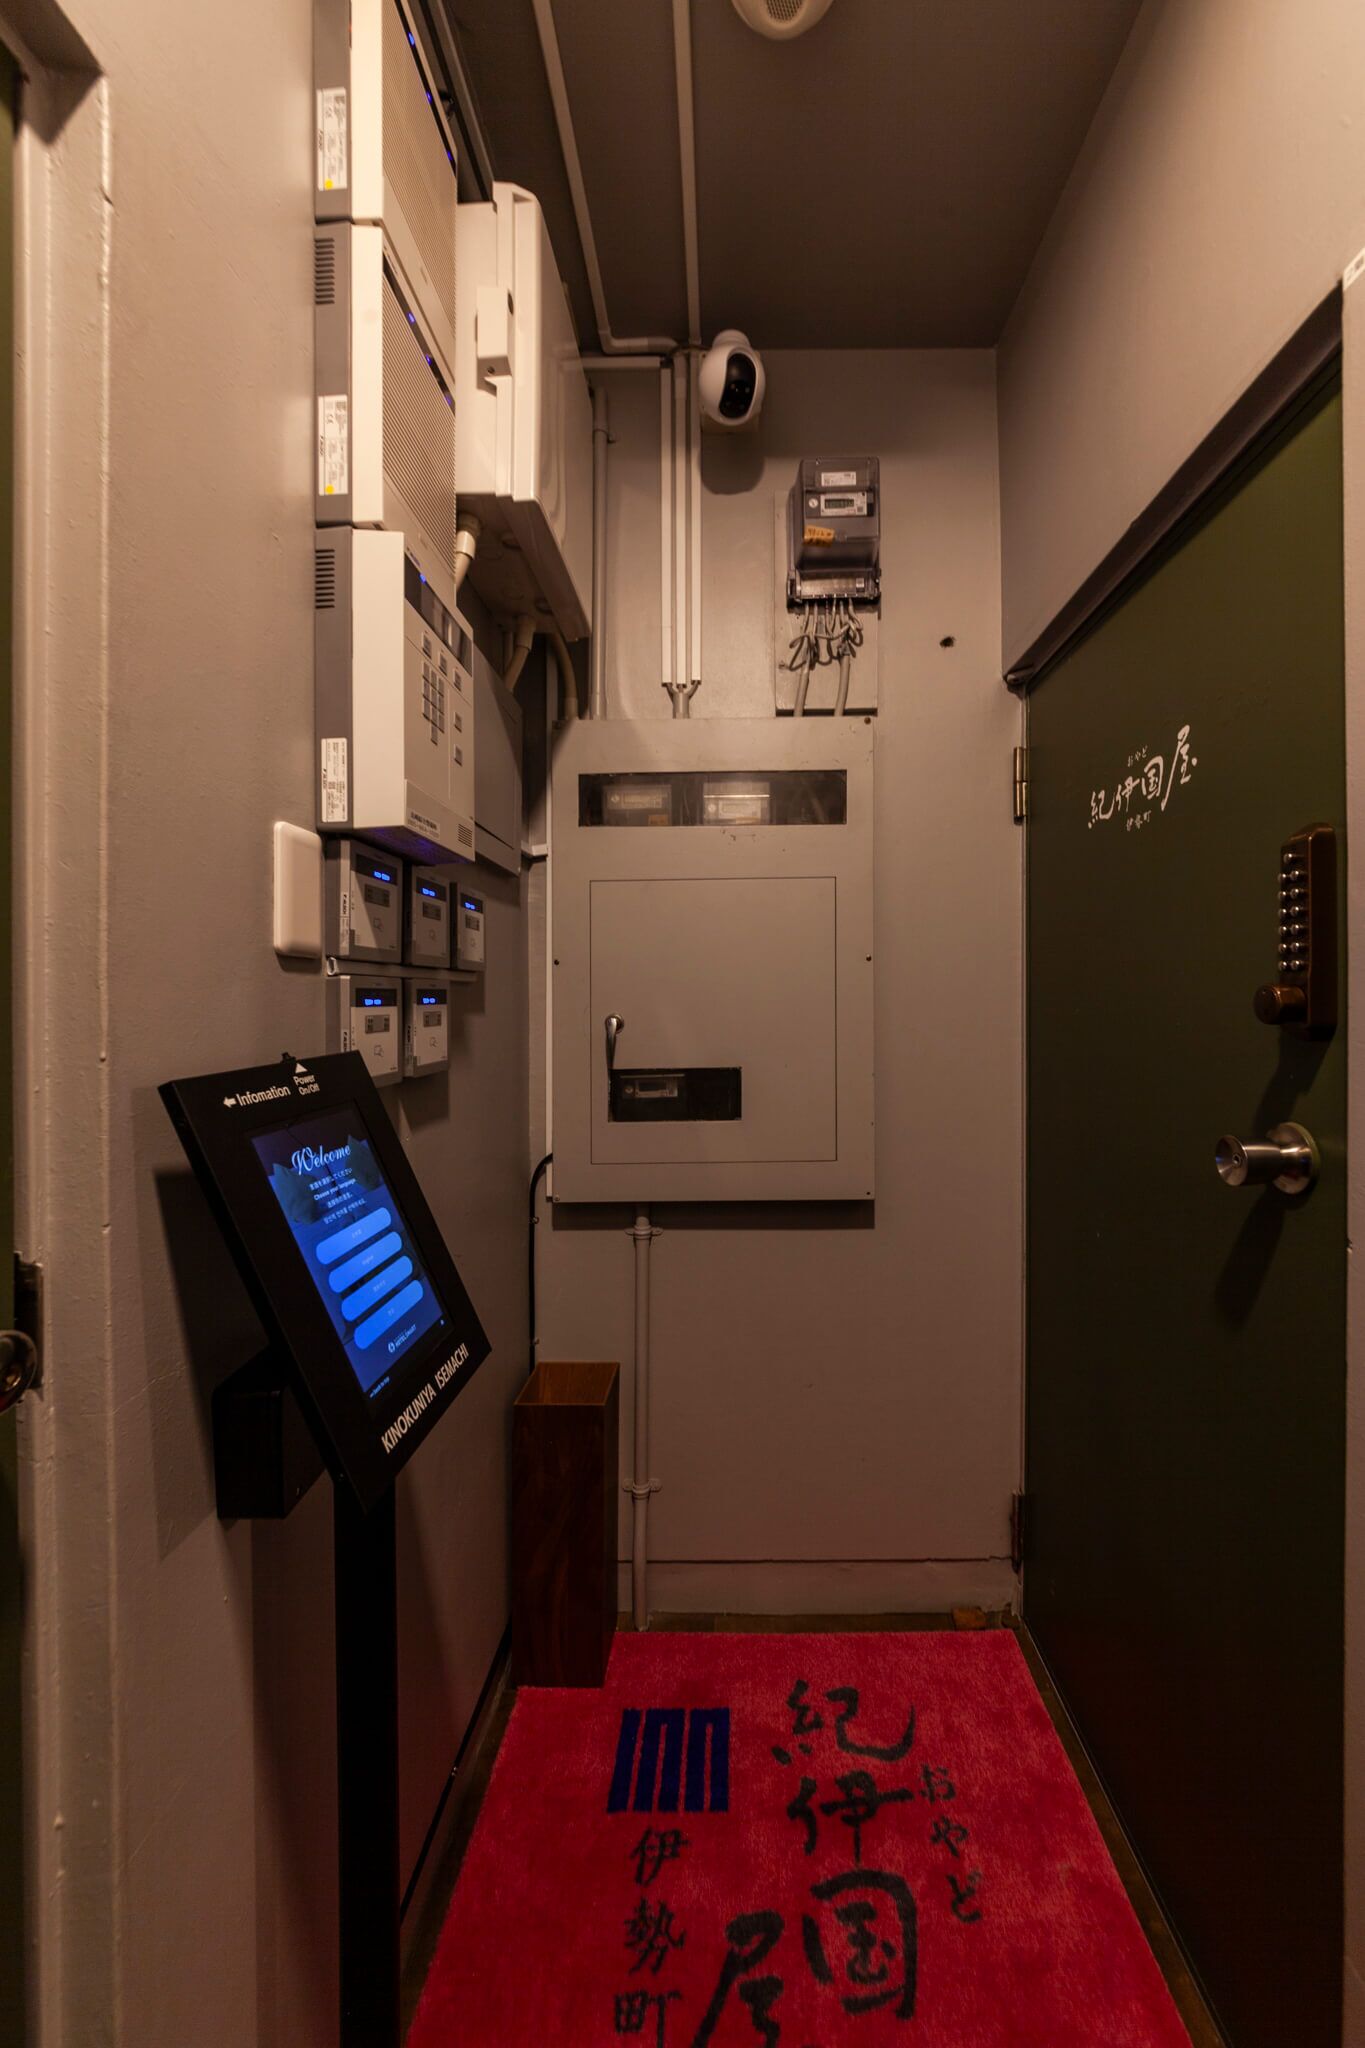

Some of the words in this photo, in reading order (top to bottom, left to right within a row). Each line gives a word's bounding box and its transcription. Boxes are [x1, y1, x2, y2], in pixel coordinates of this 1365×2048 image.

[1088, 725, 1197, 829] 紀伊国屋
[236, 1087, 291, 1106] Infomation
[293, 1074, 316, 1087] Power
[291, 1145, 351, 1176] Welcome
[381, 1382, 437, 1455] KINOKUNIYA
[434, 1341, 470, 1391] ISEMACHI
[919, 1764, 982, 1924] おやど
[614, 1827, 690, 2048] 伊勢町
